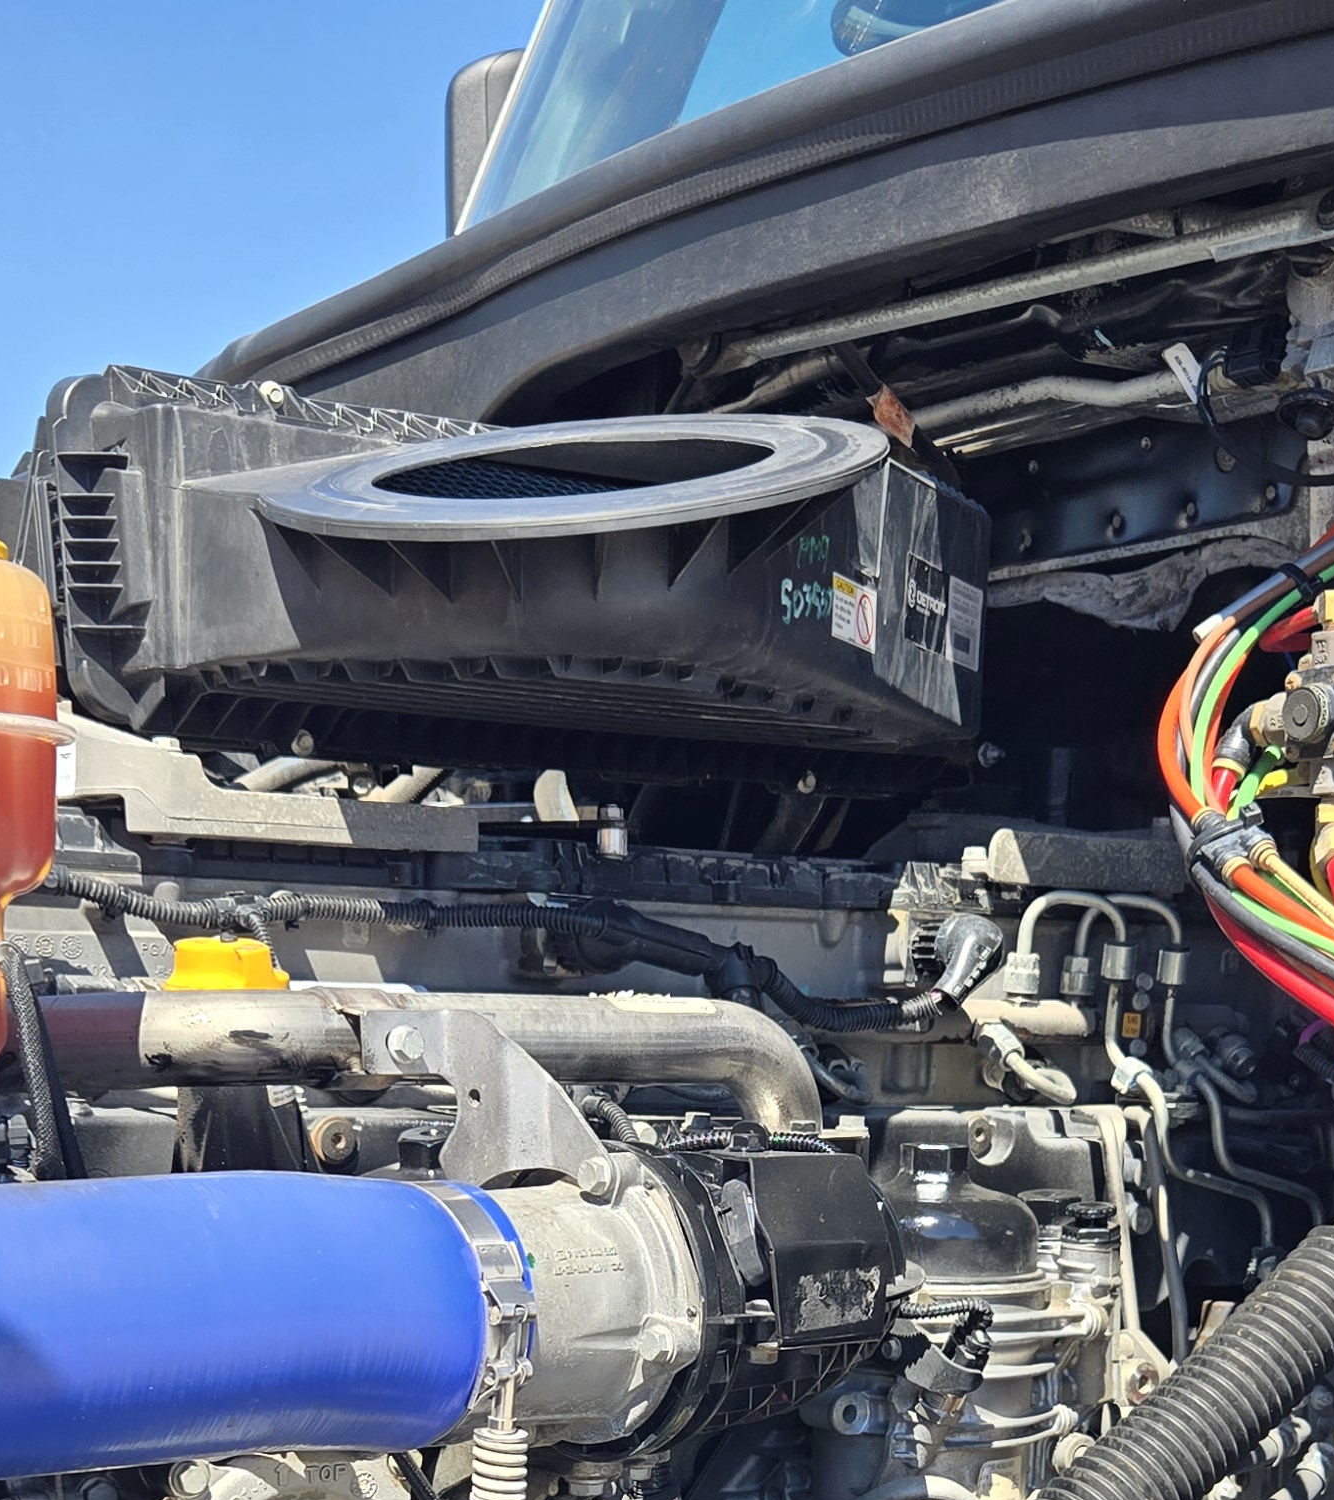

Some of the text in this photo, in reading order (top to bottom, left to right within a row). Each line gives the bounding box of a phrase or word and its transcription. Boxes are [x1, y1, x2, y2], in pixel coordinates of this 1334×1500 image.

[835, 579, 856, 597] CAUTION
[917, 590, 946, 617] DETROIT
[307, 1464, 349, 1484] TOP
